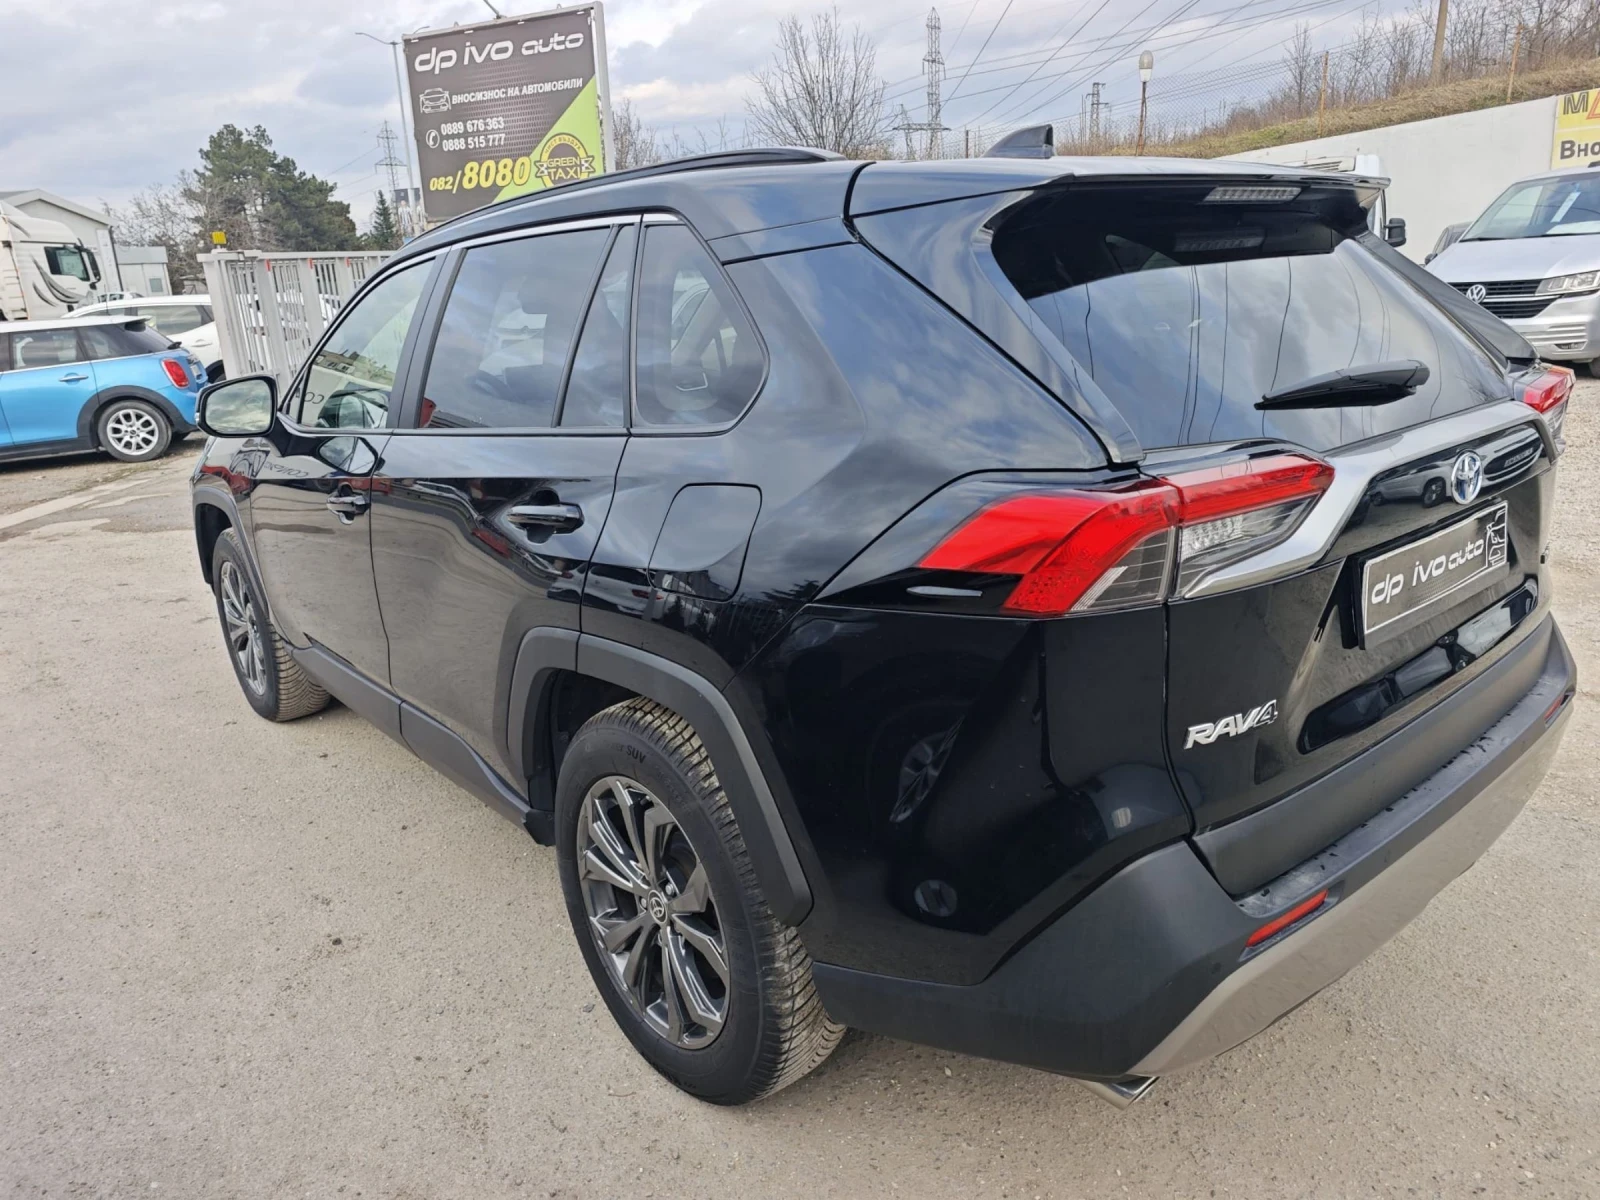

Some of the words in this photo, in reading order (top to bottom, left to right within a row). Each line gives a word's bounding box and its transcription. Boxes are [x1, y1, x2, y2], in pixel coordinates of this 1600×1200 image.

[414, 47, 457, 74] dp
[521, 32, 584, 56] auto
[452, 89, 506, 105] ВНОС/ИЗНОС
[507, 86, 520, 97] НА
[522, 77, 583, 96] АВТОМОБИЛИ
[440, 121, 465, 136] 0889
[466, 119, 485, 133] 676
[486, 117, 505, 130] 363
[442, 137, 466, 151] 0888
[469, 135, 486, 148] 515
[487, 133, 506, 146] 777
[547, 157, 580, 167] GREEN
[548, 167, 581, 180] TAXI
[1371, 573, 1405, 604] dp
[1448, 538, 1484, 569] auto
[1183, 699, 1279, 750] RAV4
[626, 744, 647, 764] SUV
